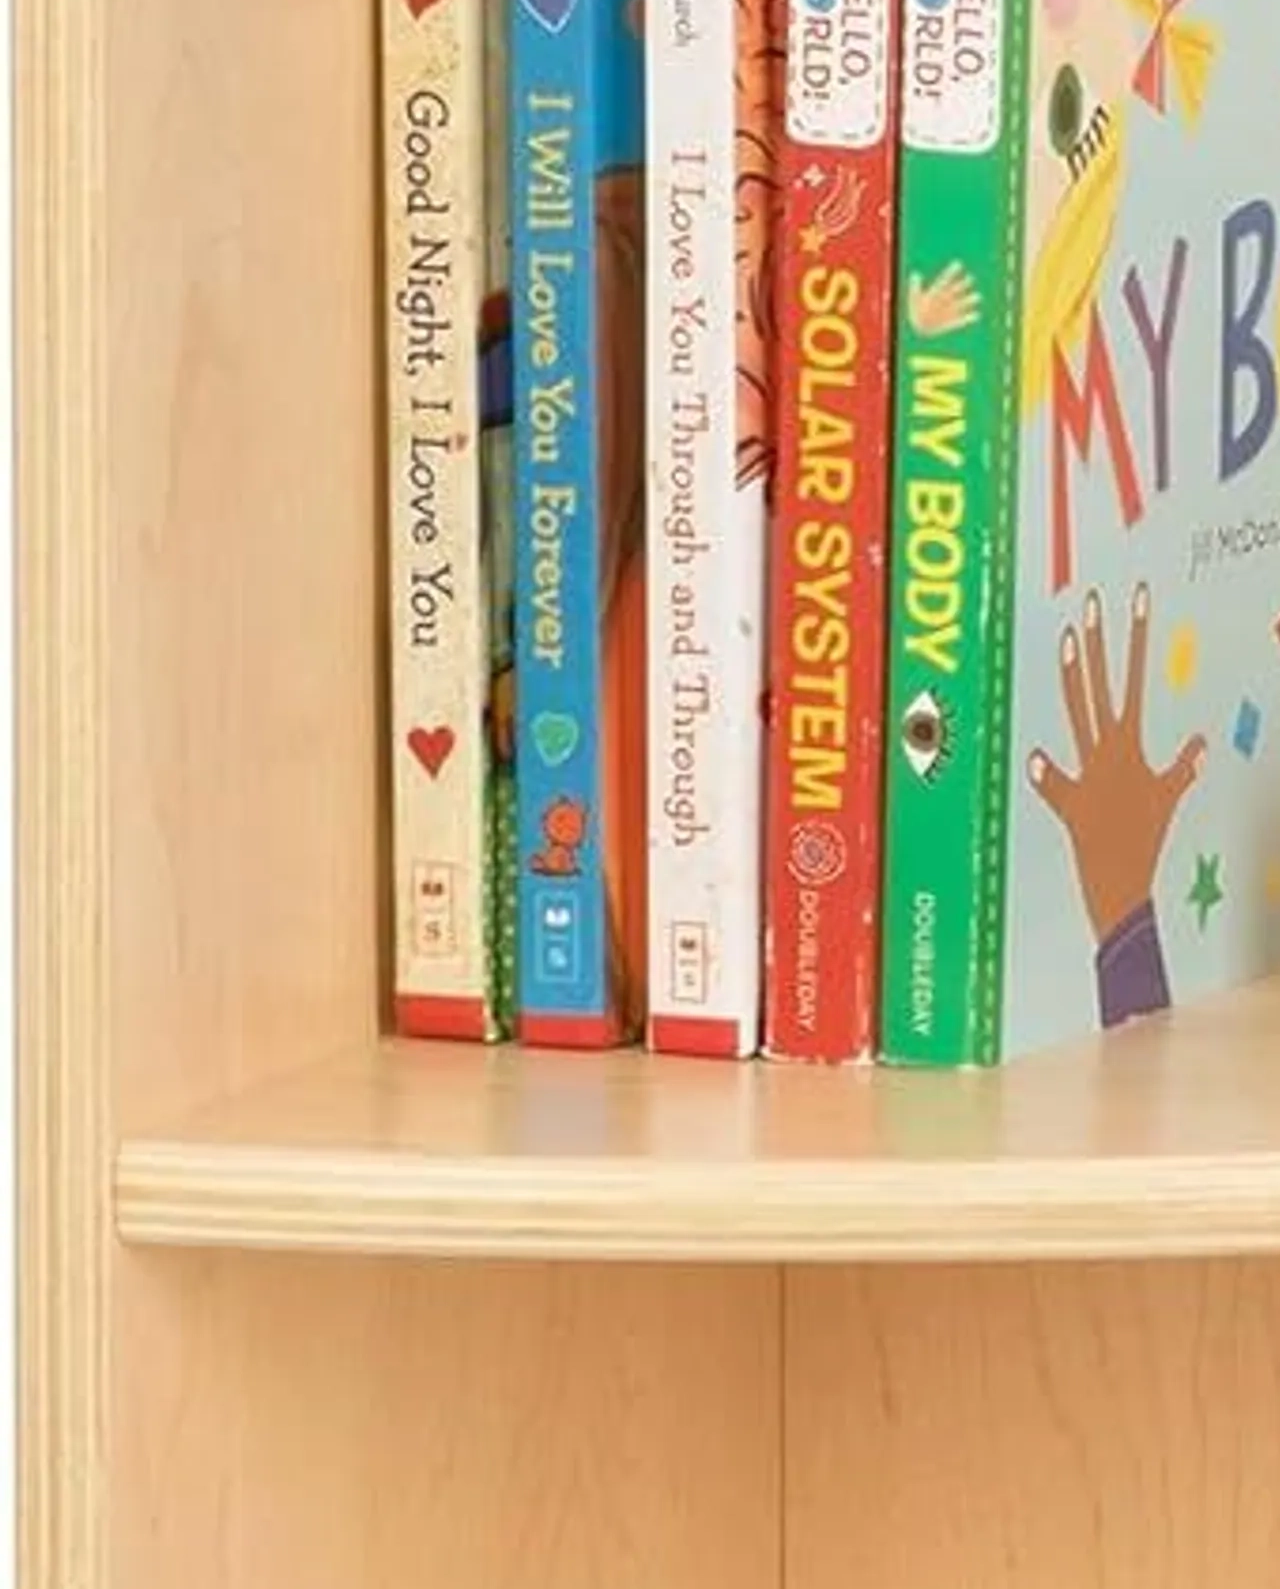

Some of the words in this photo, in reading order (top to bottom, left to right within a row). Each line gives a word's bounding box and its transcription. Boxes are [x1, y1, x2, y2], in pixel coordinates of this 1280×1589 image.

[405, 90, 451, 216] Good
[528, 93, 574, 111] I
[671, 152, 706, 166] I
[526, 129, 575, 230] Will
[670, 185, 707, 280] Love
[396, 236, 452, 376] Night,
[527, 250, 575, 369] Love
[670, 298, 707, 376] You
[411, 399, 452, 412] I
[530, 377, 575, 463] You
[798, 266, 859, 503] SOLAR
[907, 354, 969, 469] MY
[1050, 236, 1189, 596] MY
[410, 434, 451, 545] Love
[662, 393, 711, 565] Through
[411, 562, 454, 648] You
[531, 483, 577, 669] Forever
[670, 583, 711, 656] and
[903, 479, 966, 674] BODY
[788, 520, 853, 809] SYSTEM
[663, 674, 712, 847] Through
